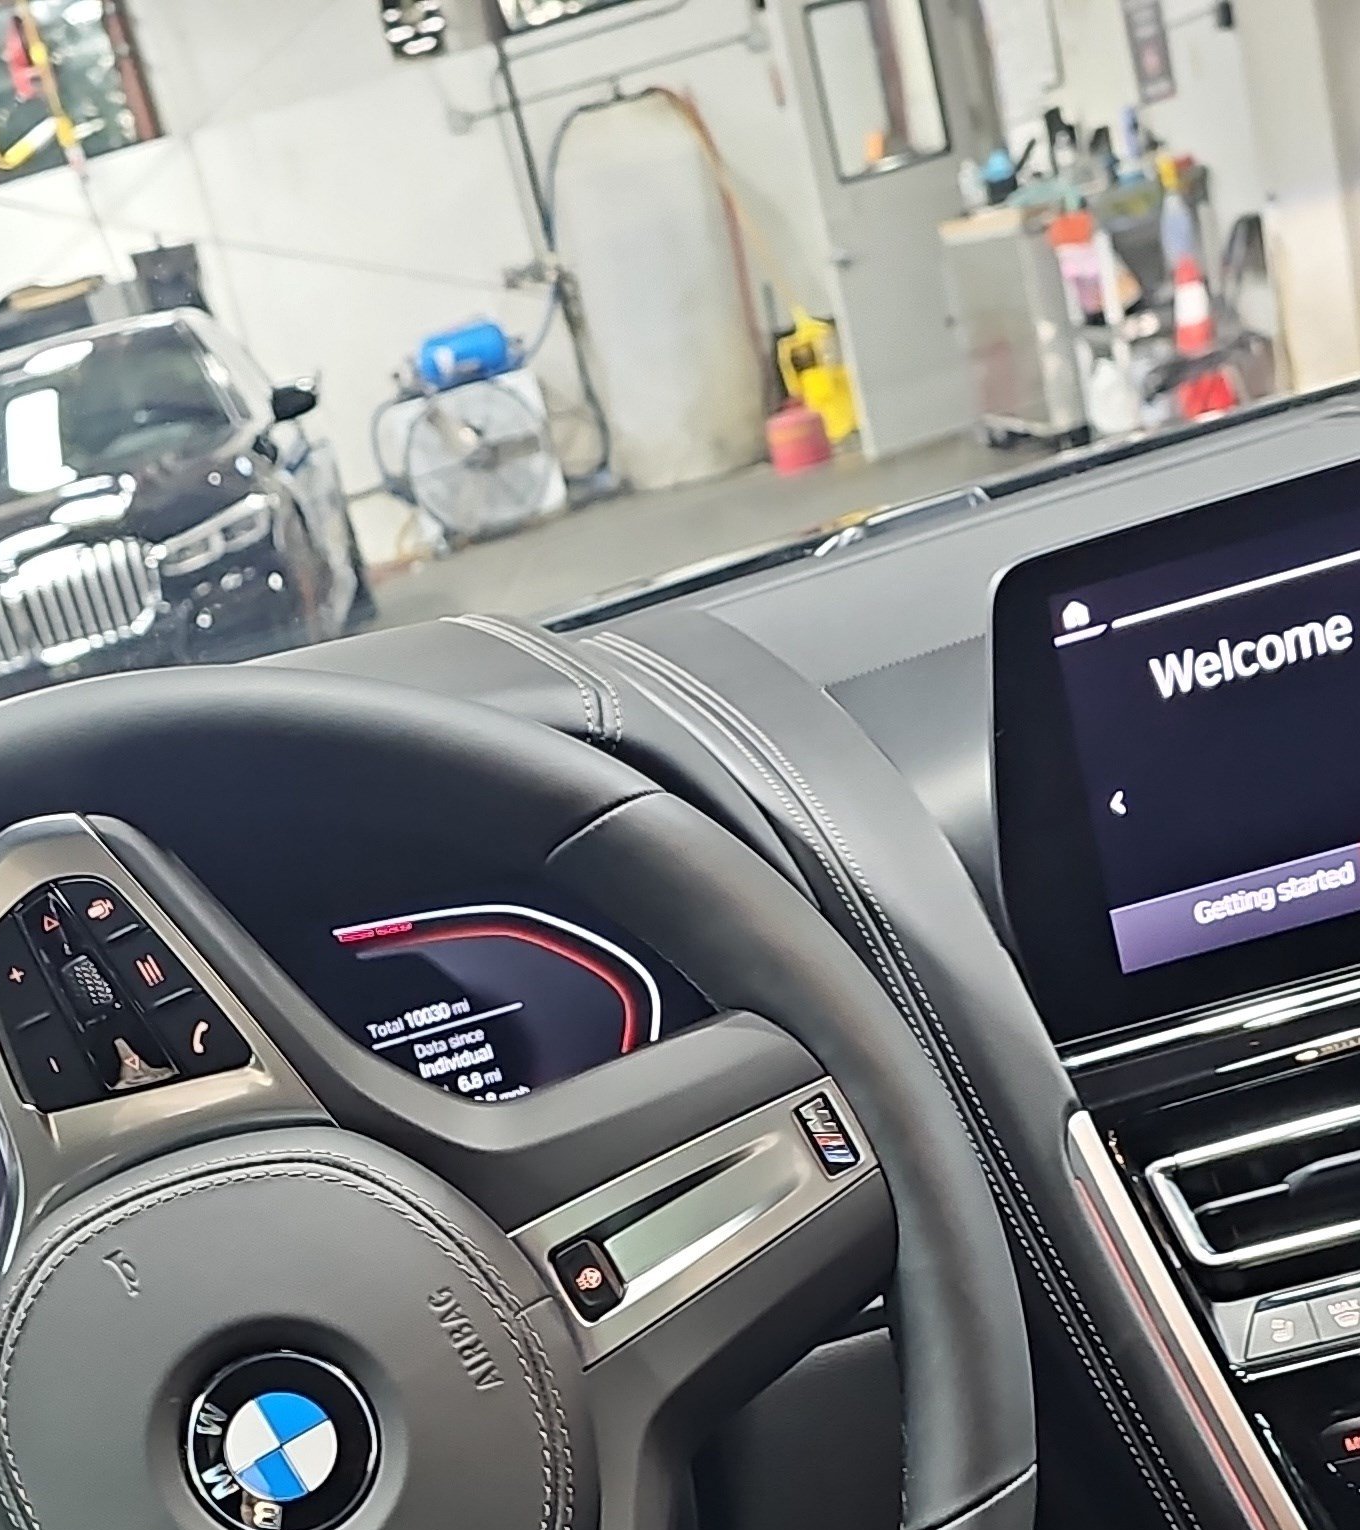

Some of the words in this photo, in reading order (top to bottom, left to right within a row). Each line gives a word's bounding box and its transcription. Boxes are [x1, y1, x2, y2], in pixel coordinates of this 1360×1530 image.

[1148, 614, 1354, 699] Welcome
[1193, 886, 1276, 927] Getting
[1275, 860, 1356, 904] started
[367, 1017, 404, 1039] Total
[404, 1002, 451, 1030] 10030
[451, 998, 470, 1016] mi
[414, 1039, 448, 1060] Data
[447, 1028, 485, 1049] since
[419, 1043, 494, 1079] Individual
[457, 1071, 484, 1093] 6.8
[483, 1067, 503, 1084] mi
[1327, 1299, 1360, 1315] MAX
[427, 1286, 505, 1390] AIRBAG
